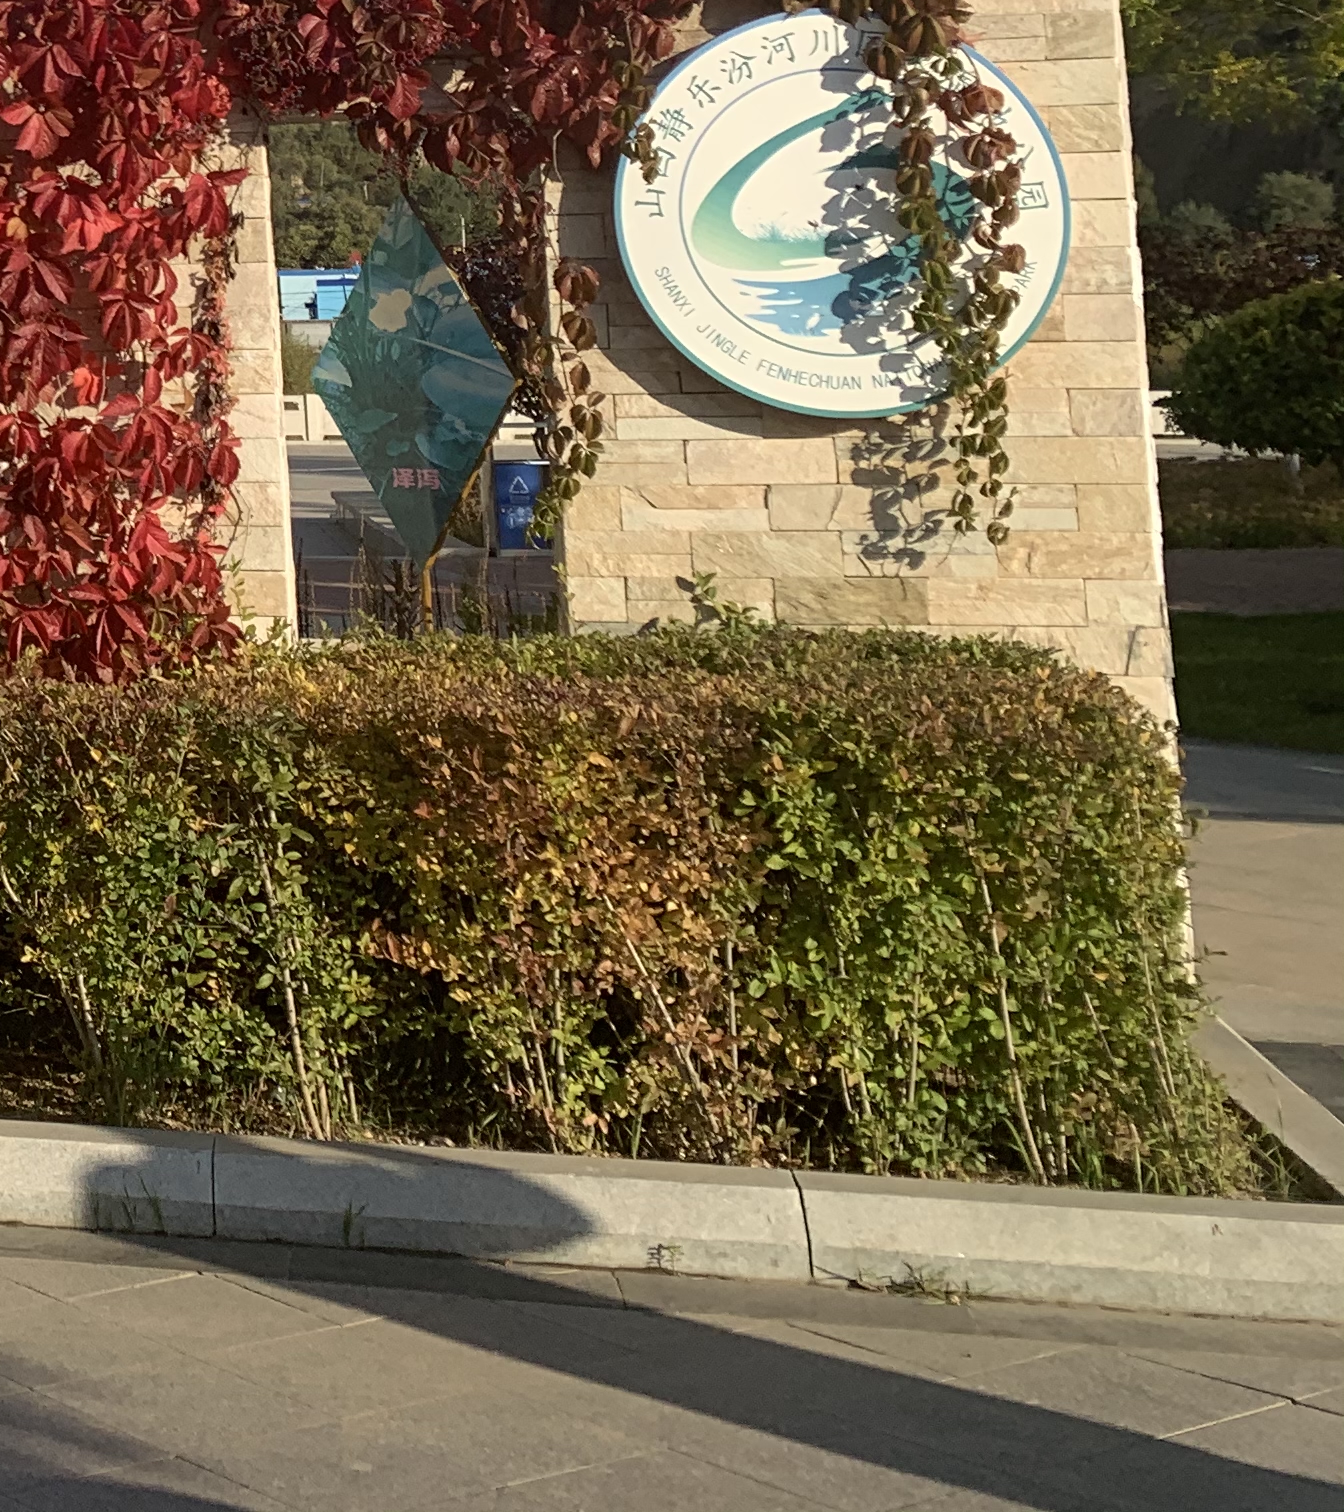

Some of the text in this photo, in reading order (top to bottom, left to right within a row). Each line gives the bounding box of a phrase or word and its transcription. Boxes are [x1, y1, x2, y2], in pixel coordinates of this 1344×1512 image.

[654, 265, 697, 318] SHANXI
[695, 323, 752, 366] JINGLE
[756, 359, 863, 390] FENHECHUAN
